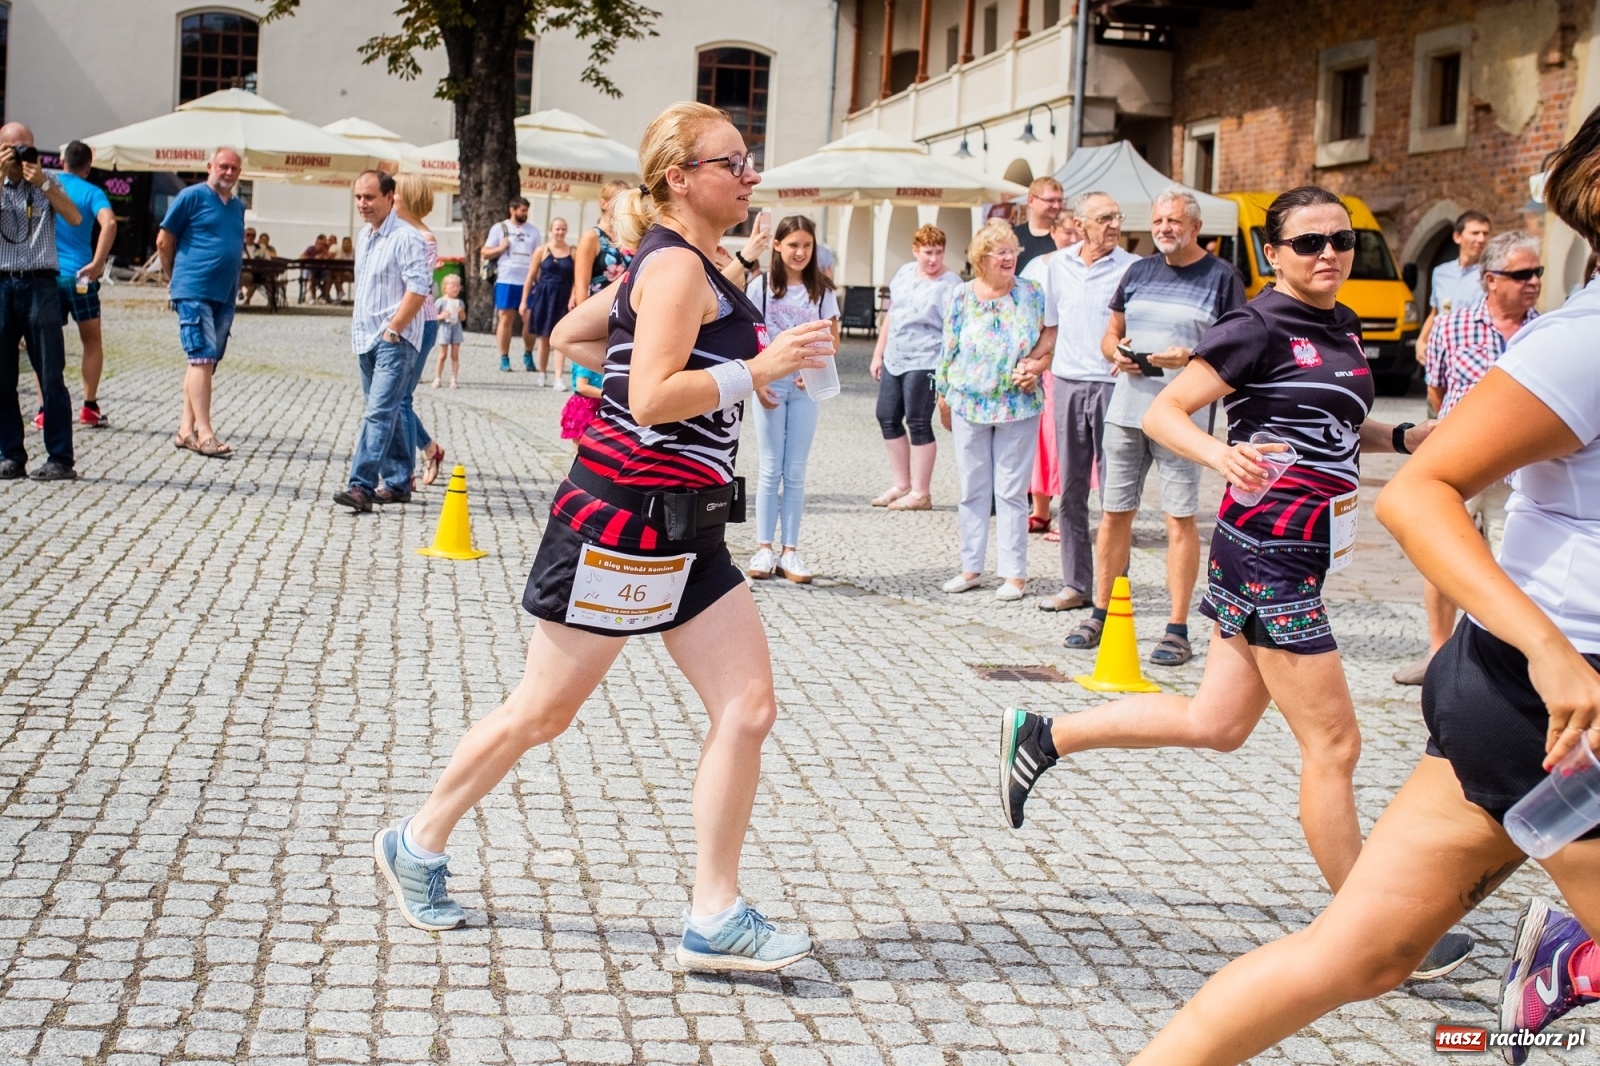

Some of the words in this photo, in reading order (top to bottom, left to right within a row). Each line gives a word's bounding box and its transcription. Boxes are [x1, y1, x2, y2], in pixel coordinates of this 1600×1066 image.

[528, 168, 604, 184] RACIBORSKIE
[604, 561, 620, 570] Bieg
[617, 584, 647, 603] 46
